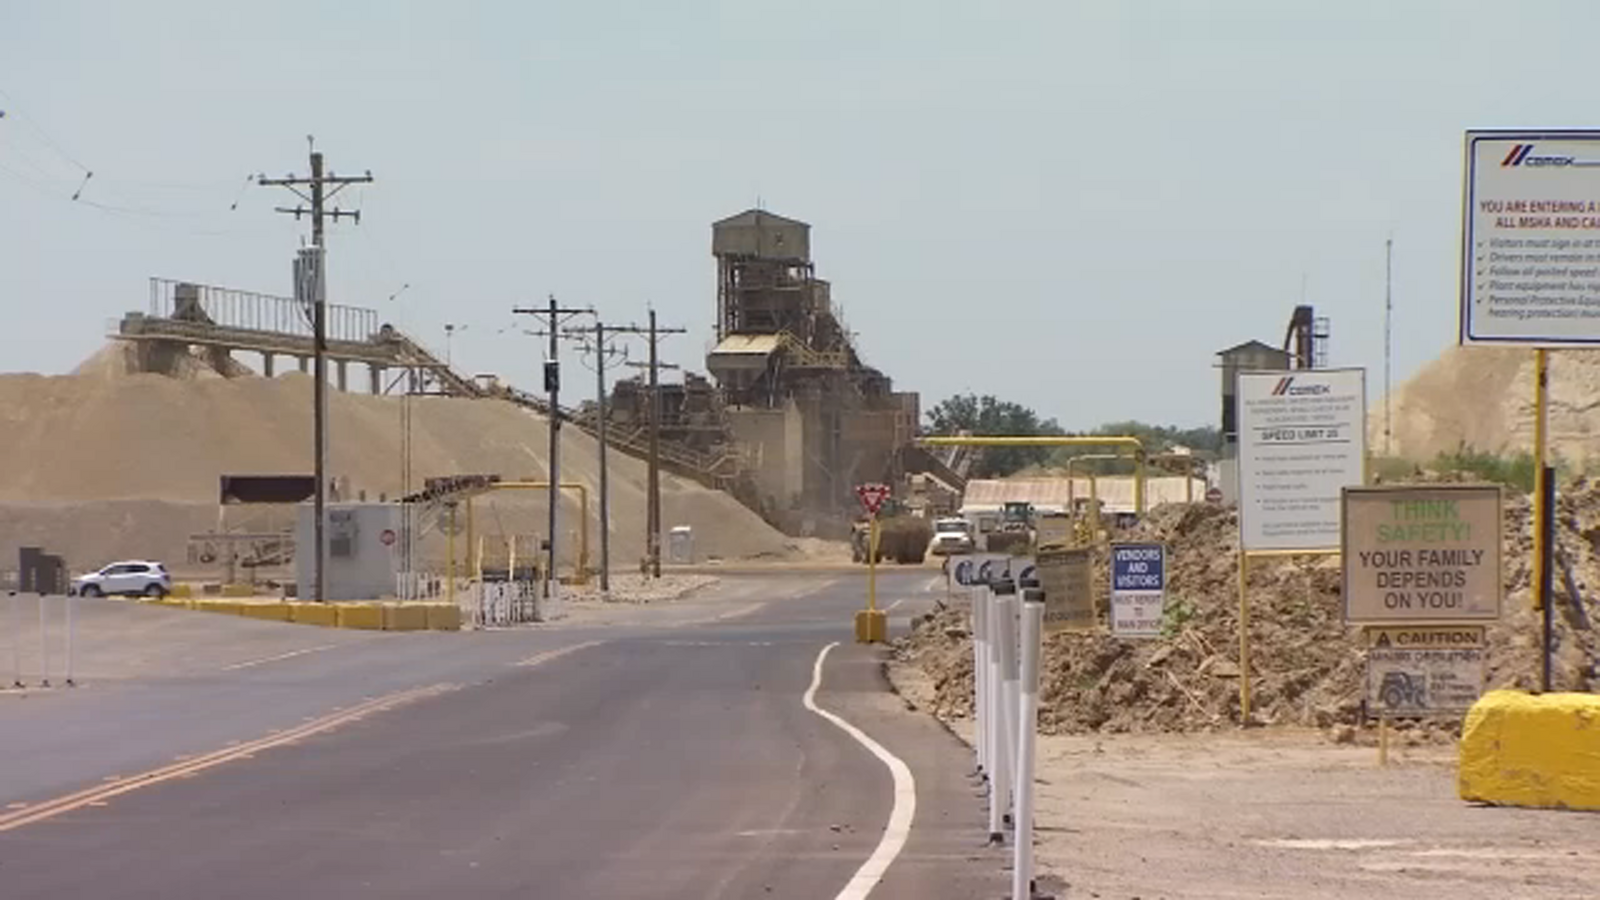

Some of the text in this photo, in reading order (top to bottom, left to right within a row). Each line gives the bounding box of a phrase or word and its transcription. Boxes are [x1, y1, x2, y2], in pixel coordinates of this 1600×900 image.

[1480, 200, 1503, 213] YOU
[1505, 200, 1527, 213] ARE
[1529, 200, 1585, 213] ENTERING
[1587, 201, 1595, 213] A
[1495, 217, 1515, 228] ALL
[1518, 217, 1552, 229] MSHA
[1554, 217, 1580, 229] AND
[1489, 238, 1523, 248] Visitors
[1525, 239, 1550, 248] must
[1551, 240, 1570, 250] sign
[1489, 252, 1523, 262] Drivers
[1489, 265, 1520, 275] Follow
[1535, 266, 1567, 278] posted
[1569, 267, 1597, 278] speed
[1489, 280, 1513, 290] Plant
[1515, 281, 1566, 292] equipment
[1489, 295, 1528, 305] Personal
[1530, 295, 1576, 305] Protective
[1489, 307, 1525, 320] hearing
[1262, 430, 1295, 441] SPEED
[1298, 430, 1325, 440] LIMIT
[1390, 499, 1460, 521] THINK
[1377, 521, 1471, 542] SAFETY!
[1116, 549, 1160, 561] VENDORS
[1359, 549, 1484, 568] YOUR FAMILY
[1128, 562, 1148, 573] AND
[1117, 575, 1160, 587] VISITORS
[1377, 571, 1466, 588] DEPENDS
[1384, 591, 1411, 609] ON
[1417, 591, 1463, 609] YOU!
[1397, 631, 1478, 645] CAUTION
